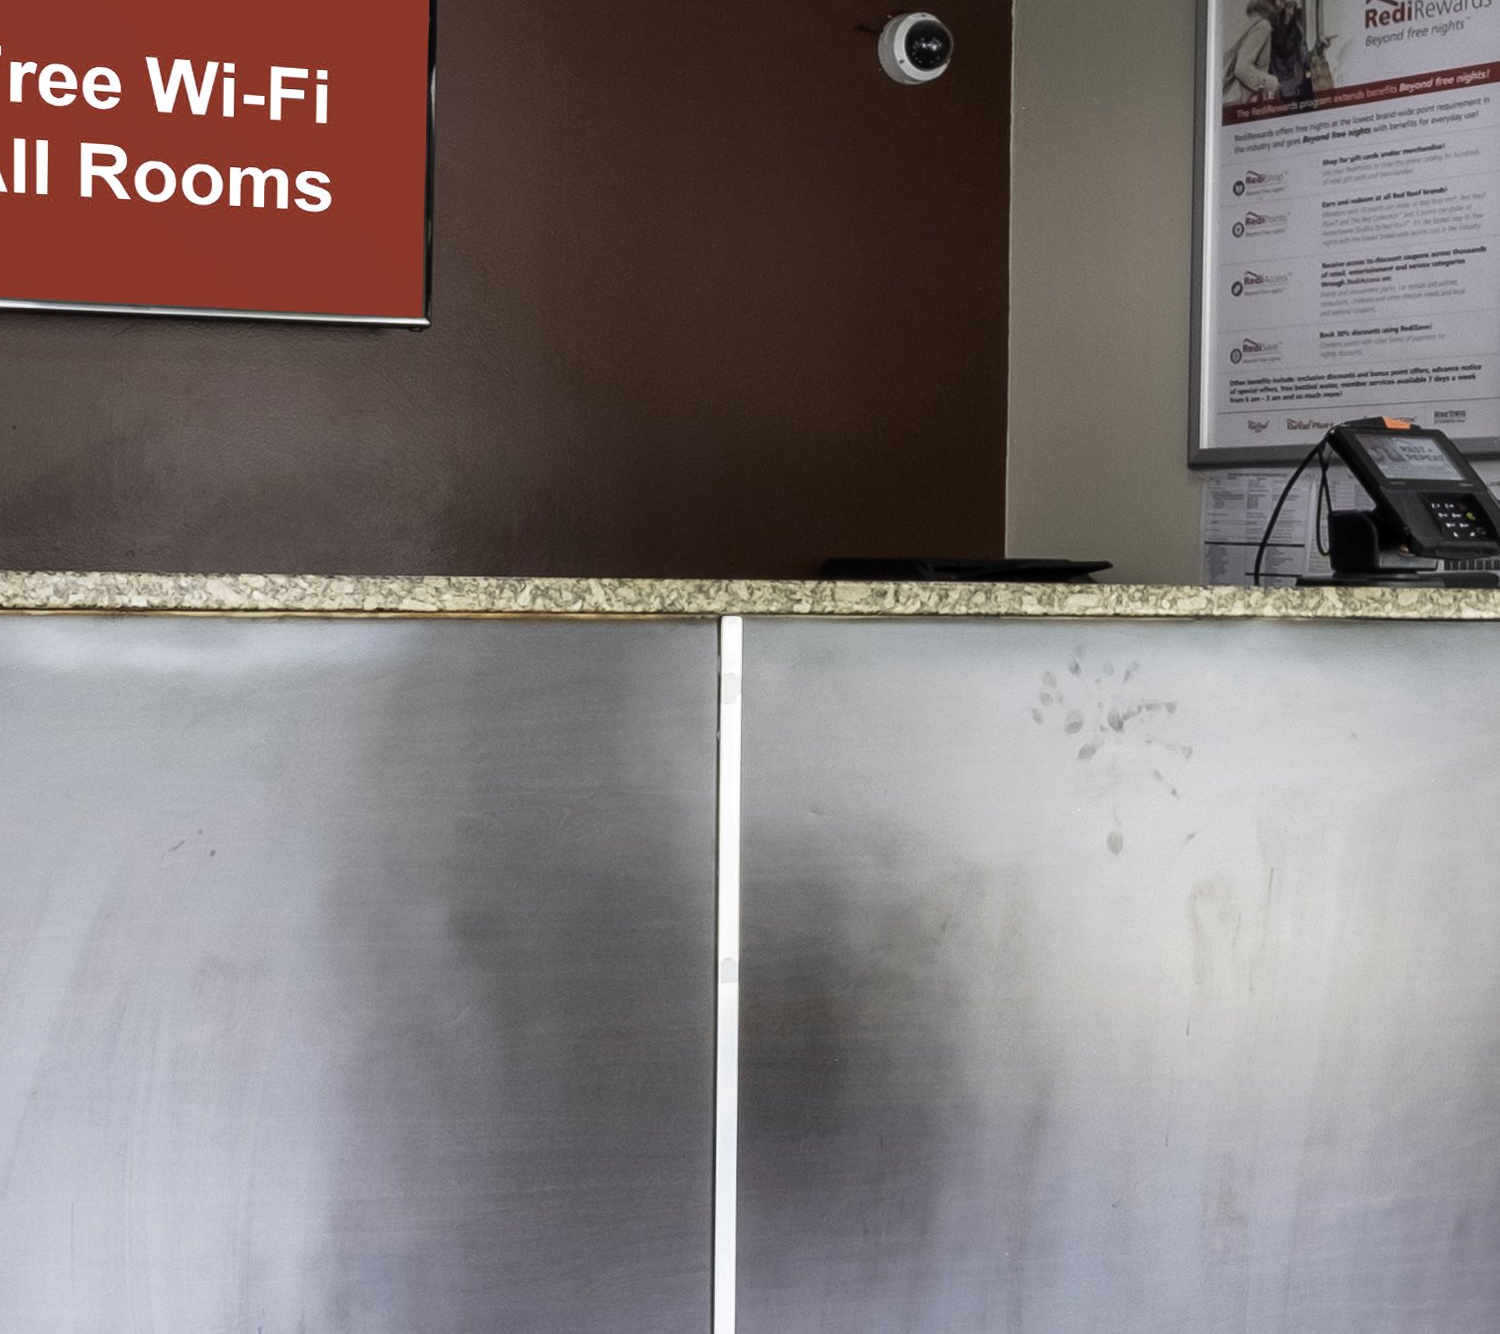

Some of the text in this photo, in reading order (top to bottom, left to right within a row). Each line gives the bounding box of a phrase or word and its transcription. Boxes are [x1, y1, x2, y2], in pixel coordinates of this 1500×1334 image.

[1365, 29, 1403, 47] Beyond
[1407, 26, 1428, 38] free
[144, 55, 329, 124] Wi-Fi
[1299, 96, 1332, 109] program
[1333, 90, 1364, 101] extends
[1366, 85, 1397, 97] benefits
[1399, 78, 1433, 93] Beyond
[1435, 76, 1454, 86] free
[1416, 105, 1435, 115] point
[1436, 98, 1481, 111] requirement
[1303, 133, 1329, 144] Beyond
[79, 141, 333, 213] Rooms
